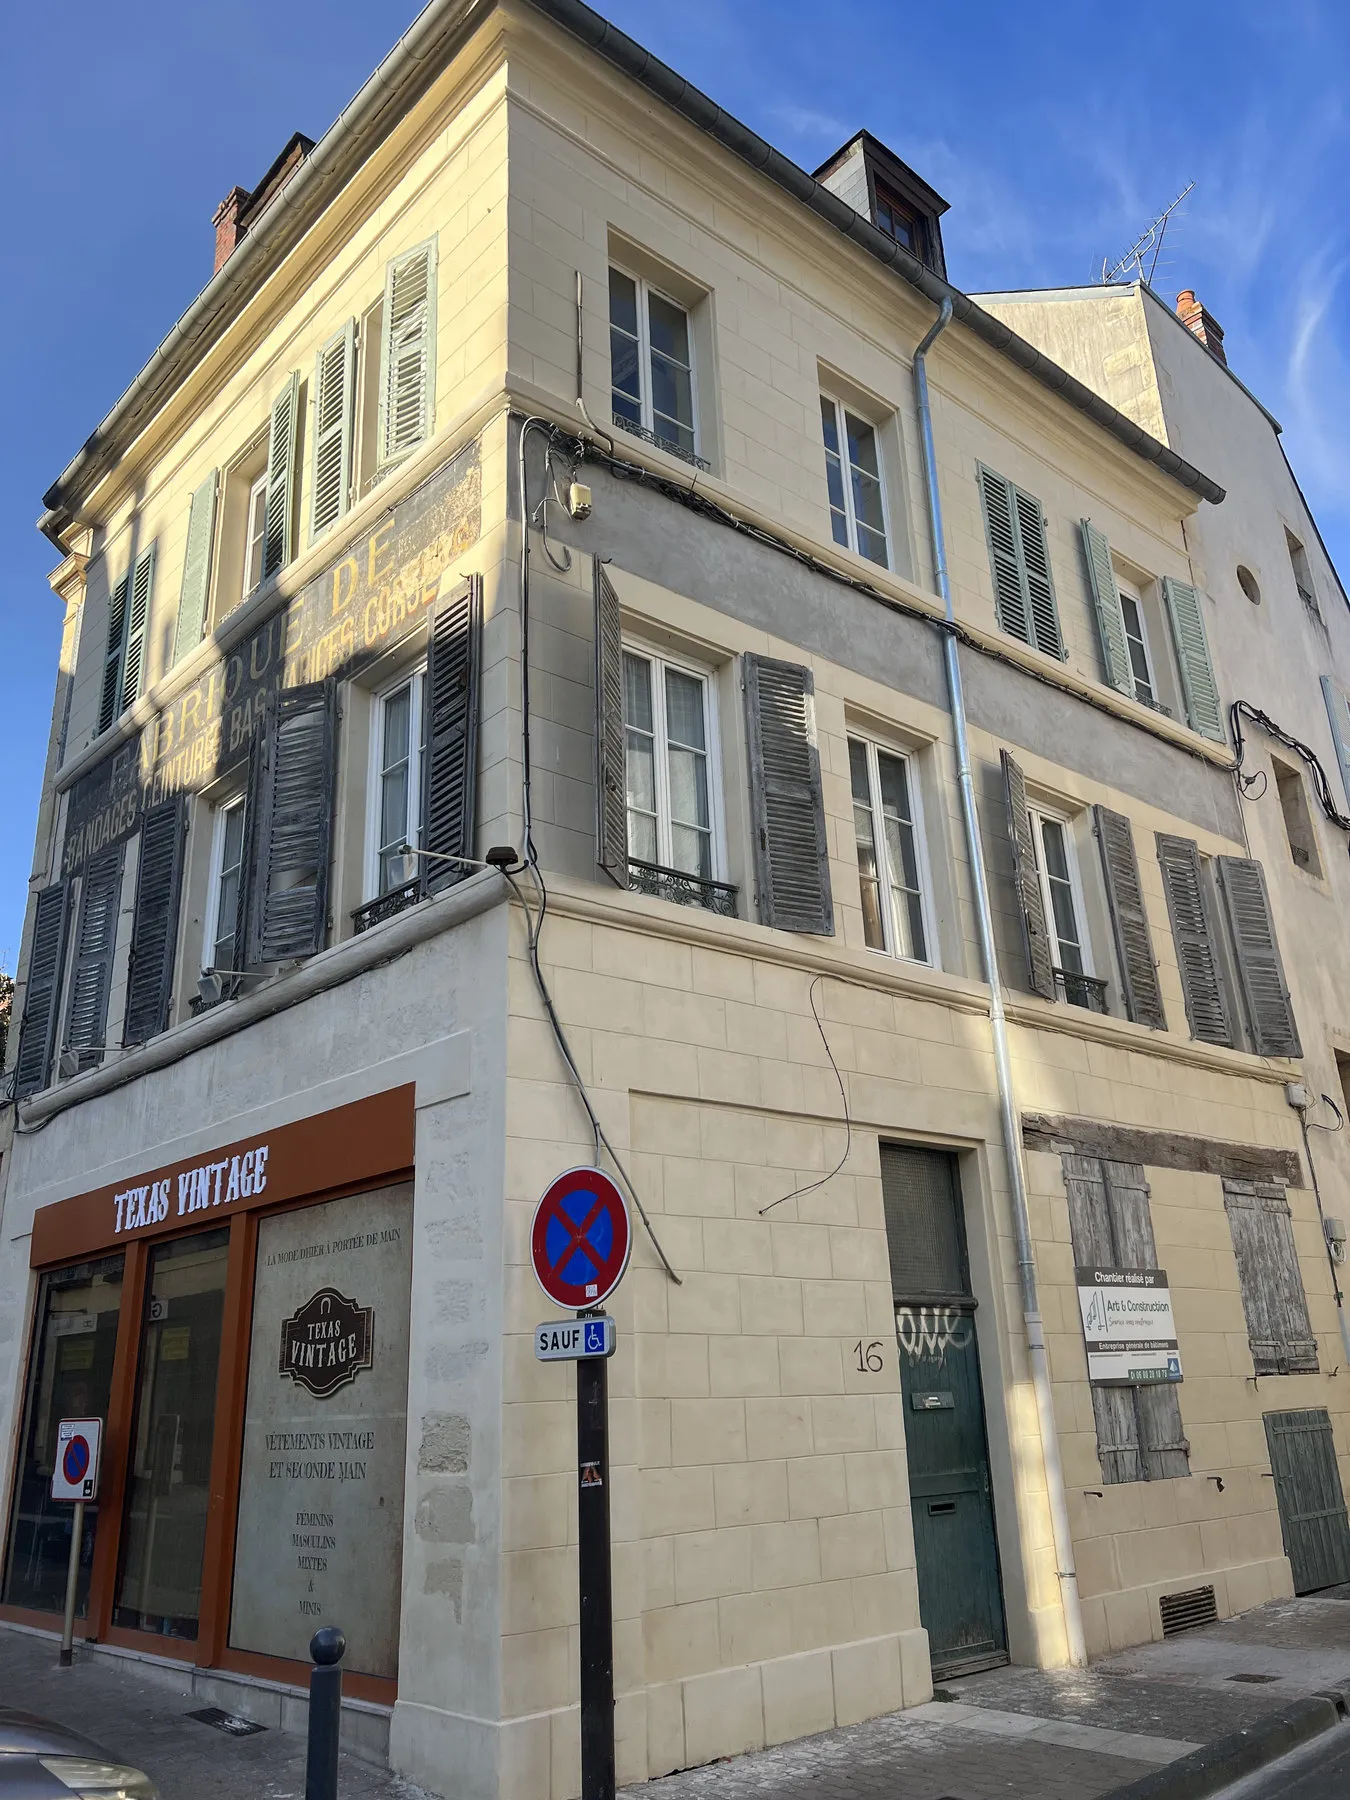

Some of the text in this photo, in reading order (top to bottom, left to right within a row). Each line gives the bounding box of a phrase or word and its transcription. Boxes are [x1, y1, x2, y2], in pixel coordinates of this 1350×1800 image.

[331, 517, 397, 618] DE
[229, 685, 267, 753] BAS
[114, 1145, 269, 1234] TEXAS VINTAGE
[267, 1254, 276, 1266] LA
[278, 1249, 299, 1265] MODE
[332, 1232, 364, 1254] PORTÉE
[366, 1232, 378, 1246] DE
[380, 1228, 401, 1243] MAIN
[1094, 1271, 1155, 1286] Chantier réalisé par
[1107, 1300, 1120, 1312] Art
[1127, 1300, 1169, 1312] Construction
[307, 1319, 341, 1341] TEXAS
[539, 1329, 580, 1351] SAUF
[1098, 1342, 1125, 1351] Entreprise
[291, 1333, 357, 1368] VINTAGE
[853, 1340, 884, 1373] 16
[328, 1431, 374, 1450] VINTAGE
[269, 1461, 367, 1480] ET SECONDE MAIN
[292, 1533, 336, 1549] MASCULINS
[297, 1555, 328, 1571] MIXTES
[307, 1579, 314, 1593] &
[298, 1600, 322, 1616] MINIS
